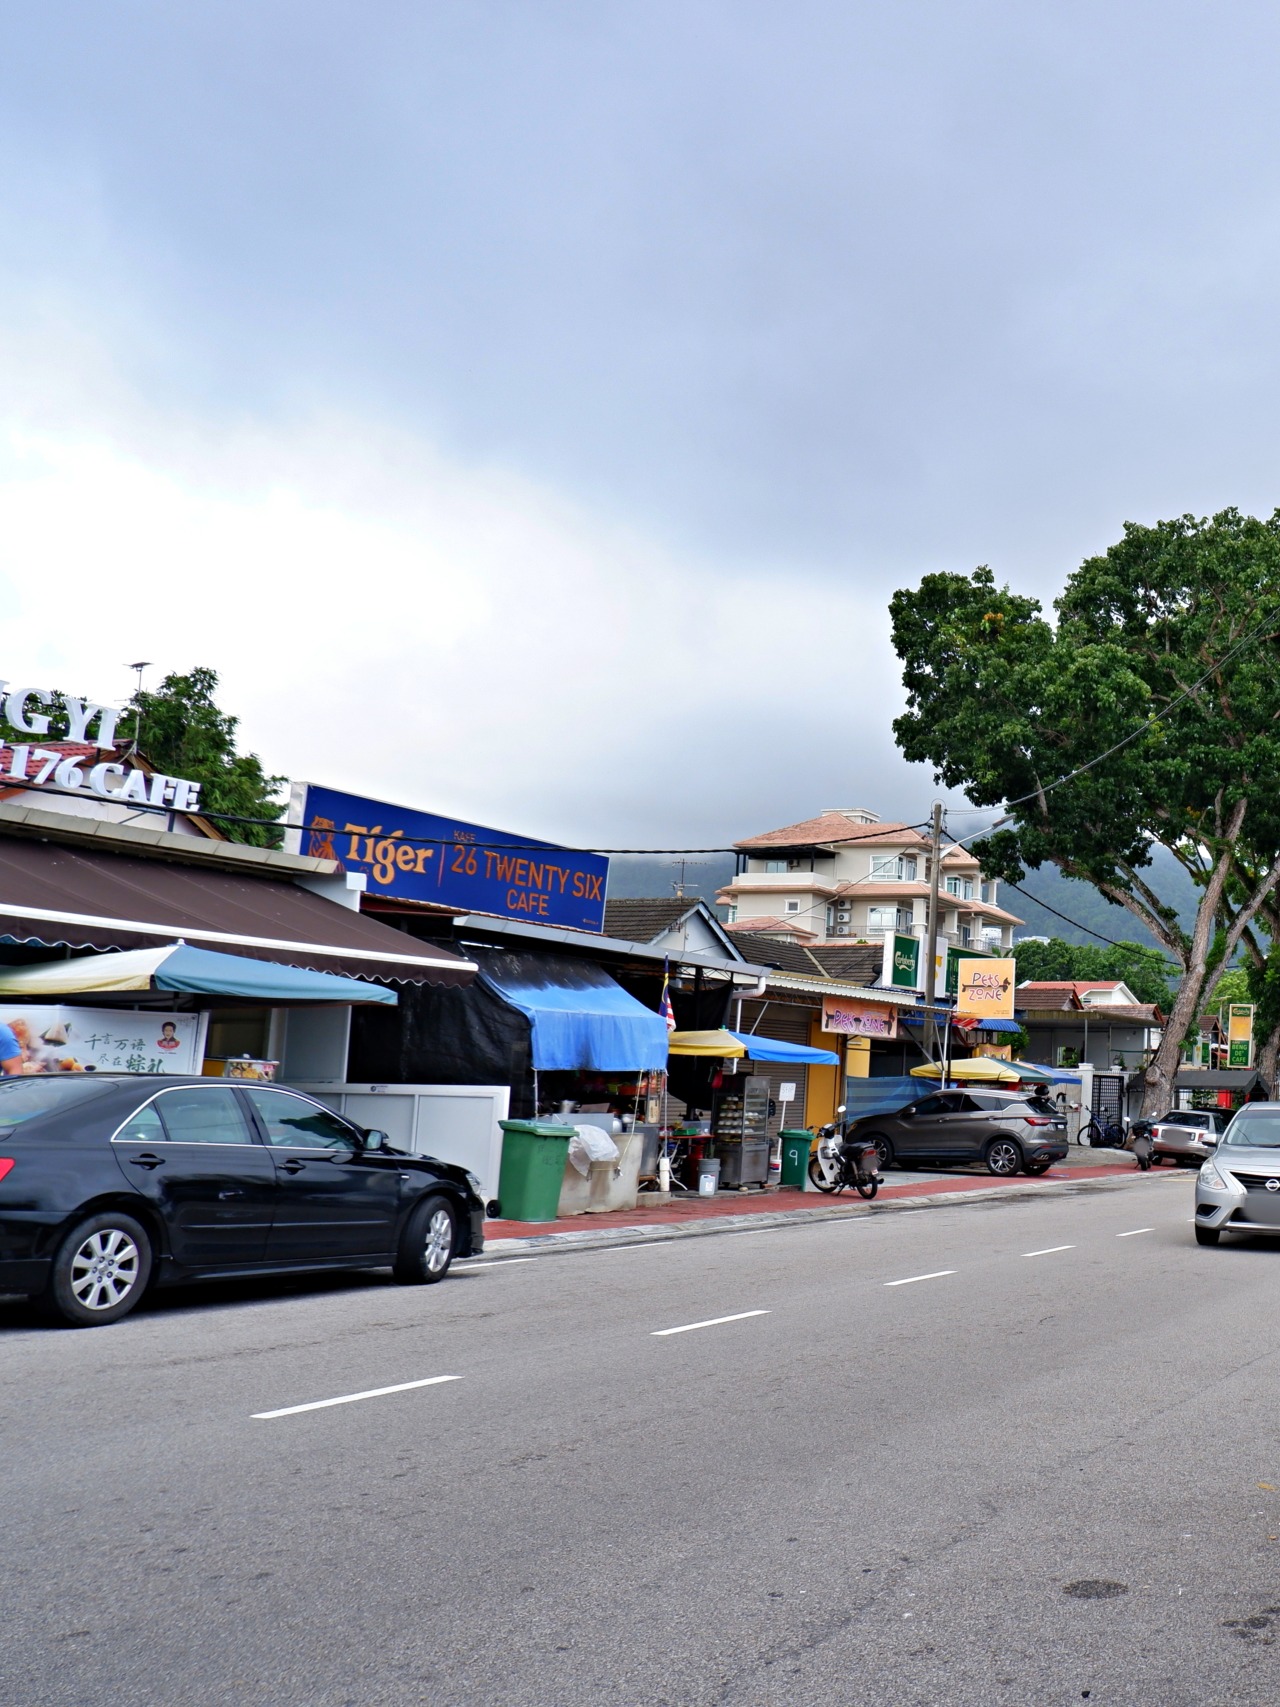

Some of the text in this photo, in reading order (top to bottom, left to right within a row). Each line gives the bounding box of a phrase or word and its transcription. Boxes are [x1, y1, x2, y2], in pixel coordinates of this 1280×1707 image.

[90, 762, 202, 812] CAFE
[344, 822, 434, 885] Tiger
[451, 845, 603, 901] 26 TWENTY SIX
[507, 888, 549, 916] CAFE
[84, 1032, 146, 1052] 千言万语
[788, 1149, 798, 1166] 9
